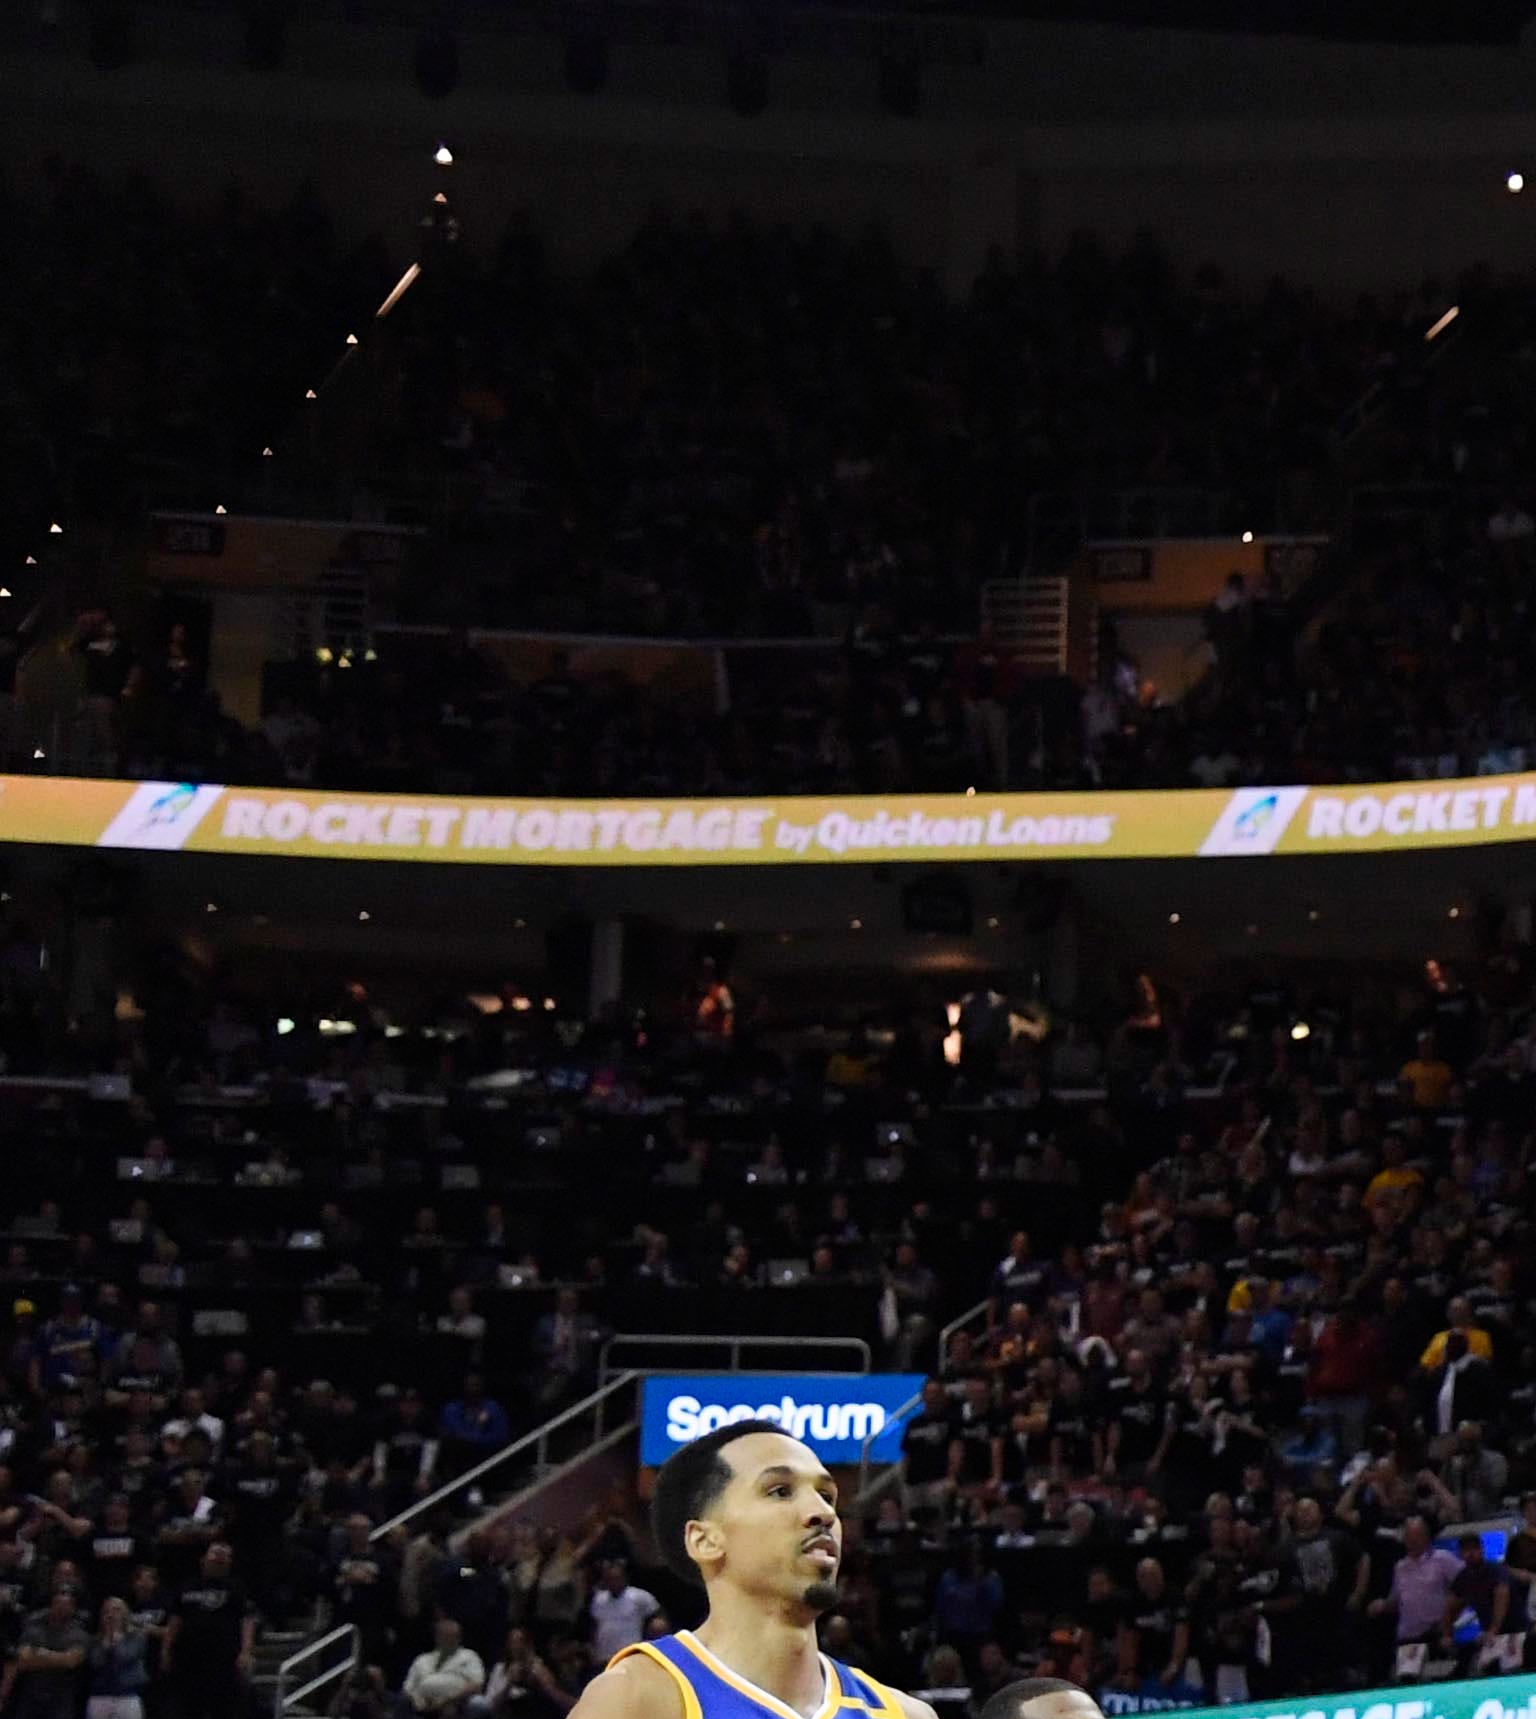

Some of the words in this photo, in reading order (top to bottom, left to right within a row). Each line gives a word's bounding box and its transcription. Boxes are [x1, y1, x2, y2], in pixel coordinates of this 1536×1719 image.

[221, 800, 460, 849] ROCKET
[461, 805, 769, 851] MORTGAGE
[775, 821, 817, 854] by
[817, 809, 985, 854] Quicken
[985, 809, 1113, 846] Loans
[1307, 787, 1511, 839] ROCKET
